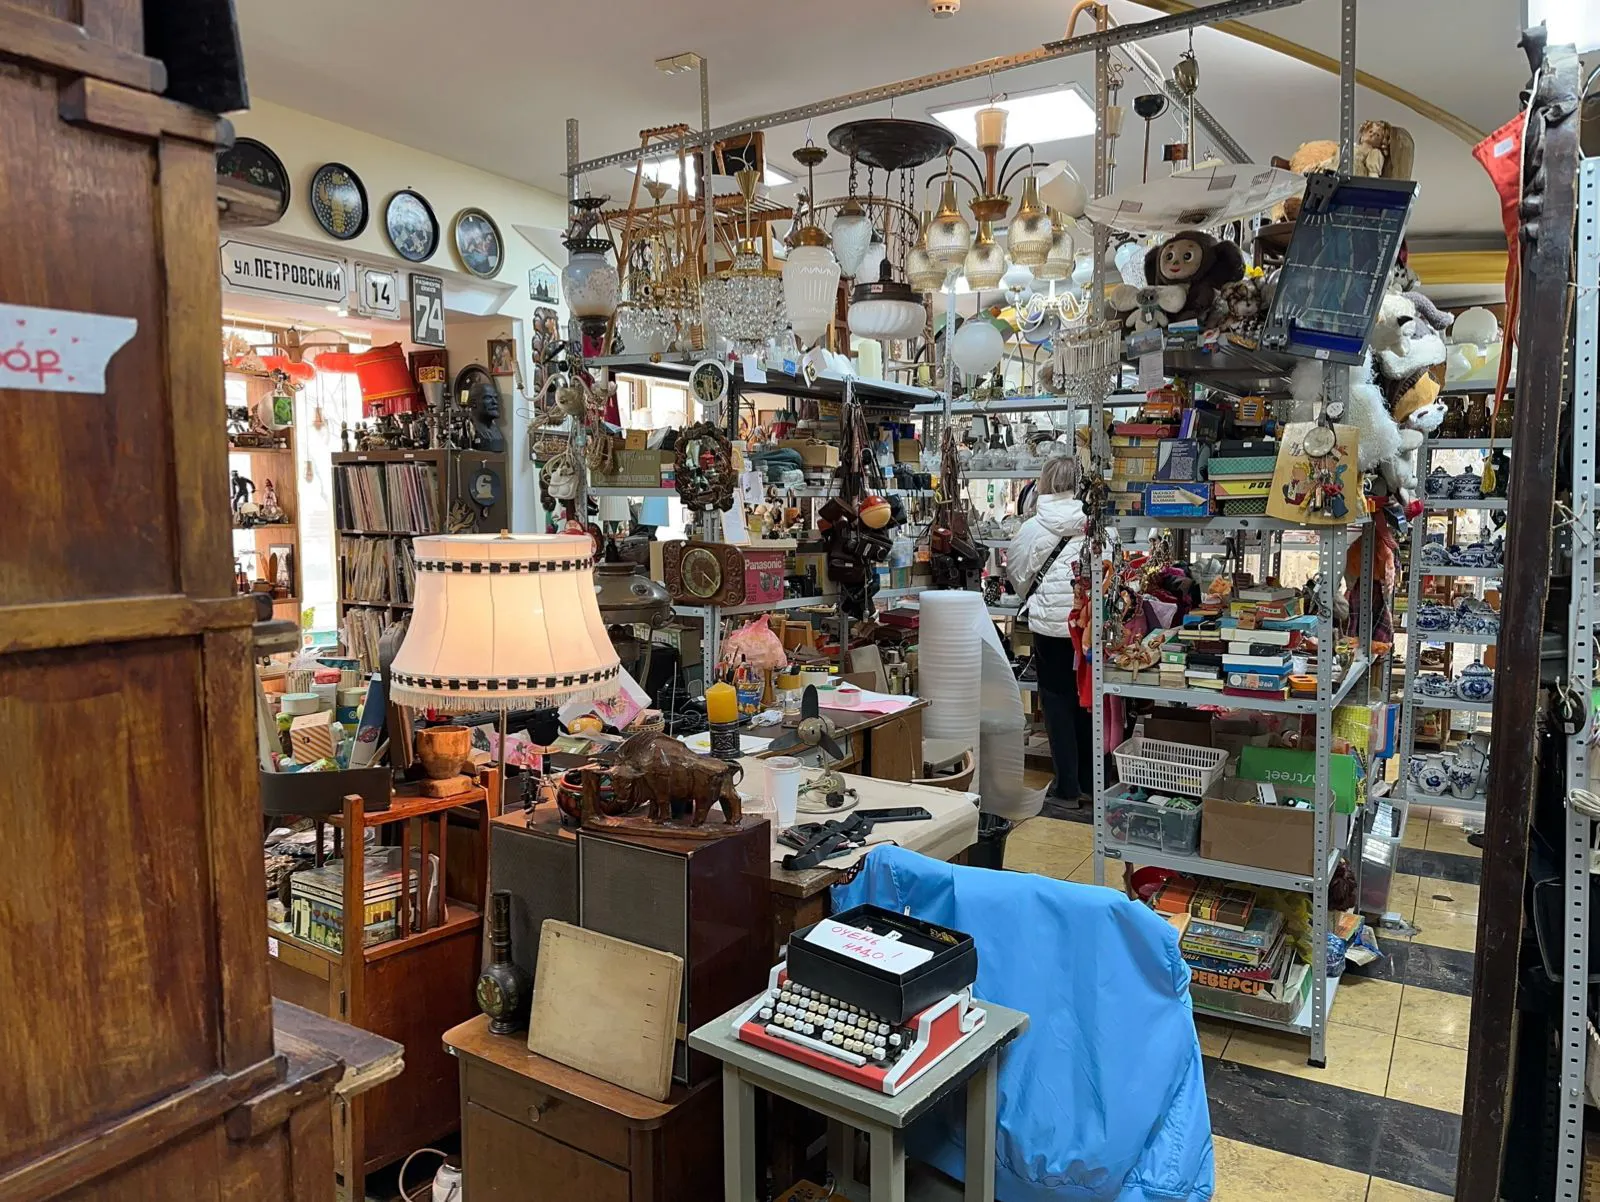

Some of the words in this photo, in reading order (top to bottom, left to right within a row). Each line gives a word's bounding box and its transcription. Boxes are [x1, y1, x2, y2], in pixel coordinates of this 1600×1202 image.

[254, 258, 341, 292] ПЕТРОВСКАЯ
[371, 281, 390, 305] 14
[415, 294, 443, 341] 74
[744, 557, 782, 571] Panasonic
[831, 926, 880, 945] ОЧЕНЬ
